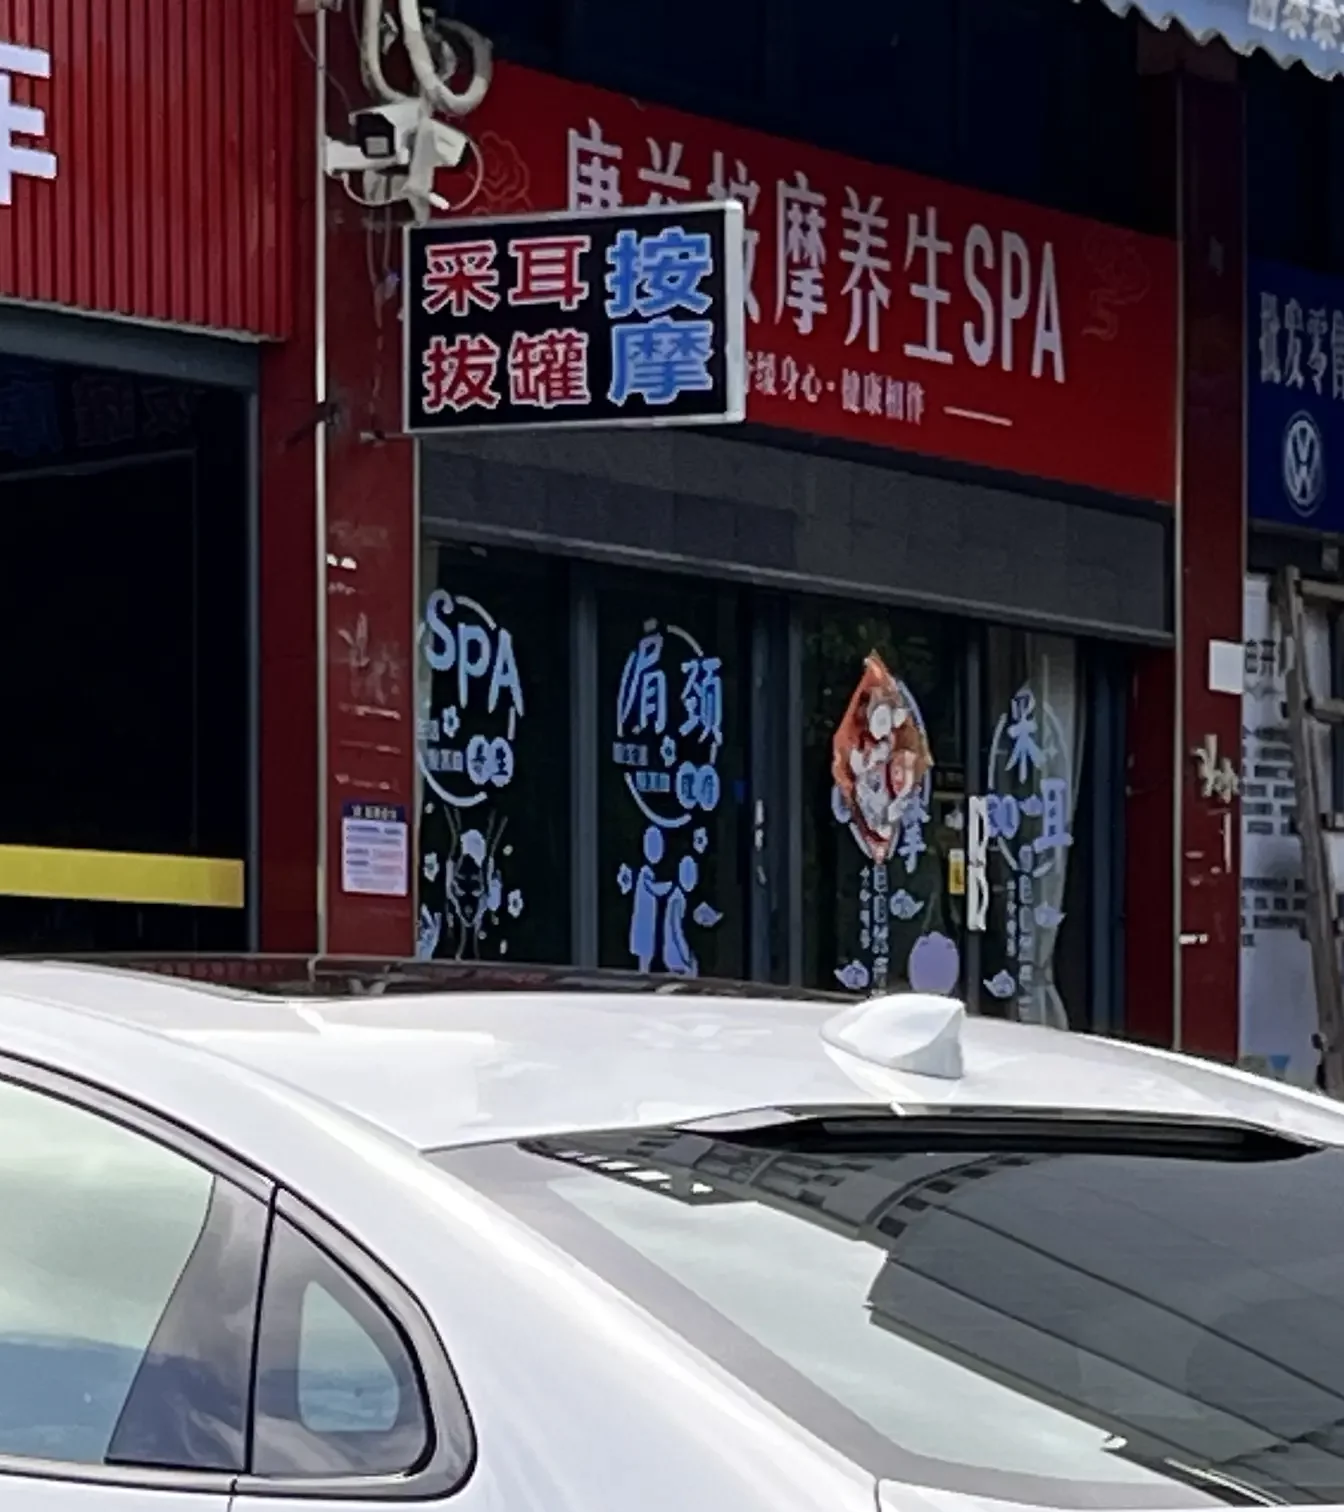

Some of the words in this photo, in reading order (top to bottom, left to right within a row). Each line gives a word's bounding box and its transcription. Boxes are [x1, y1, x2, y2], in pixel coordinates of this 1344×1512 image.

[422, 234, 592, 317] 采耳
[605, 226, 715, 407] 按摩
[422, 328, 593, 414] 拔罐
[425, 588, 525, 717] SPA
